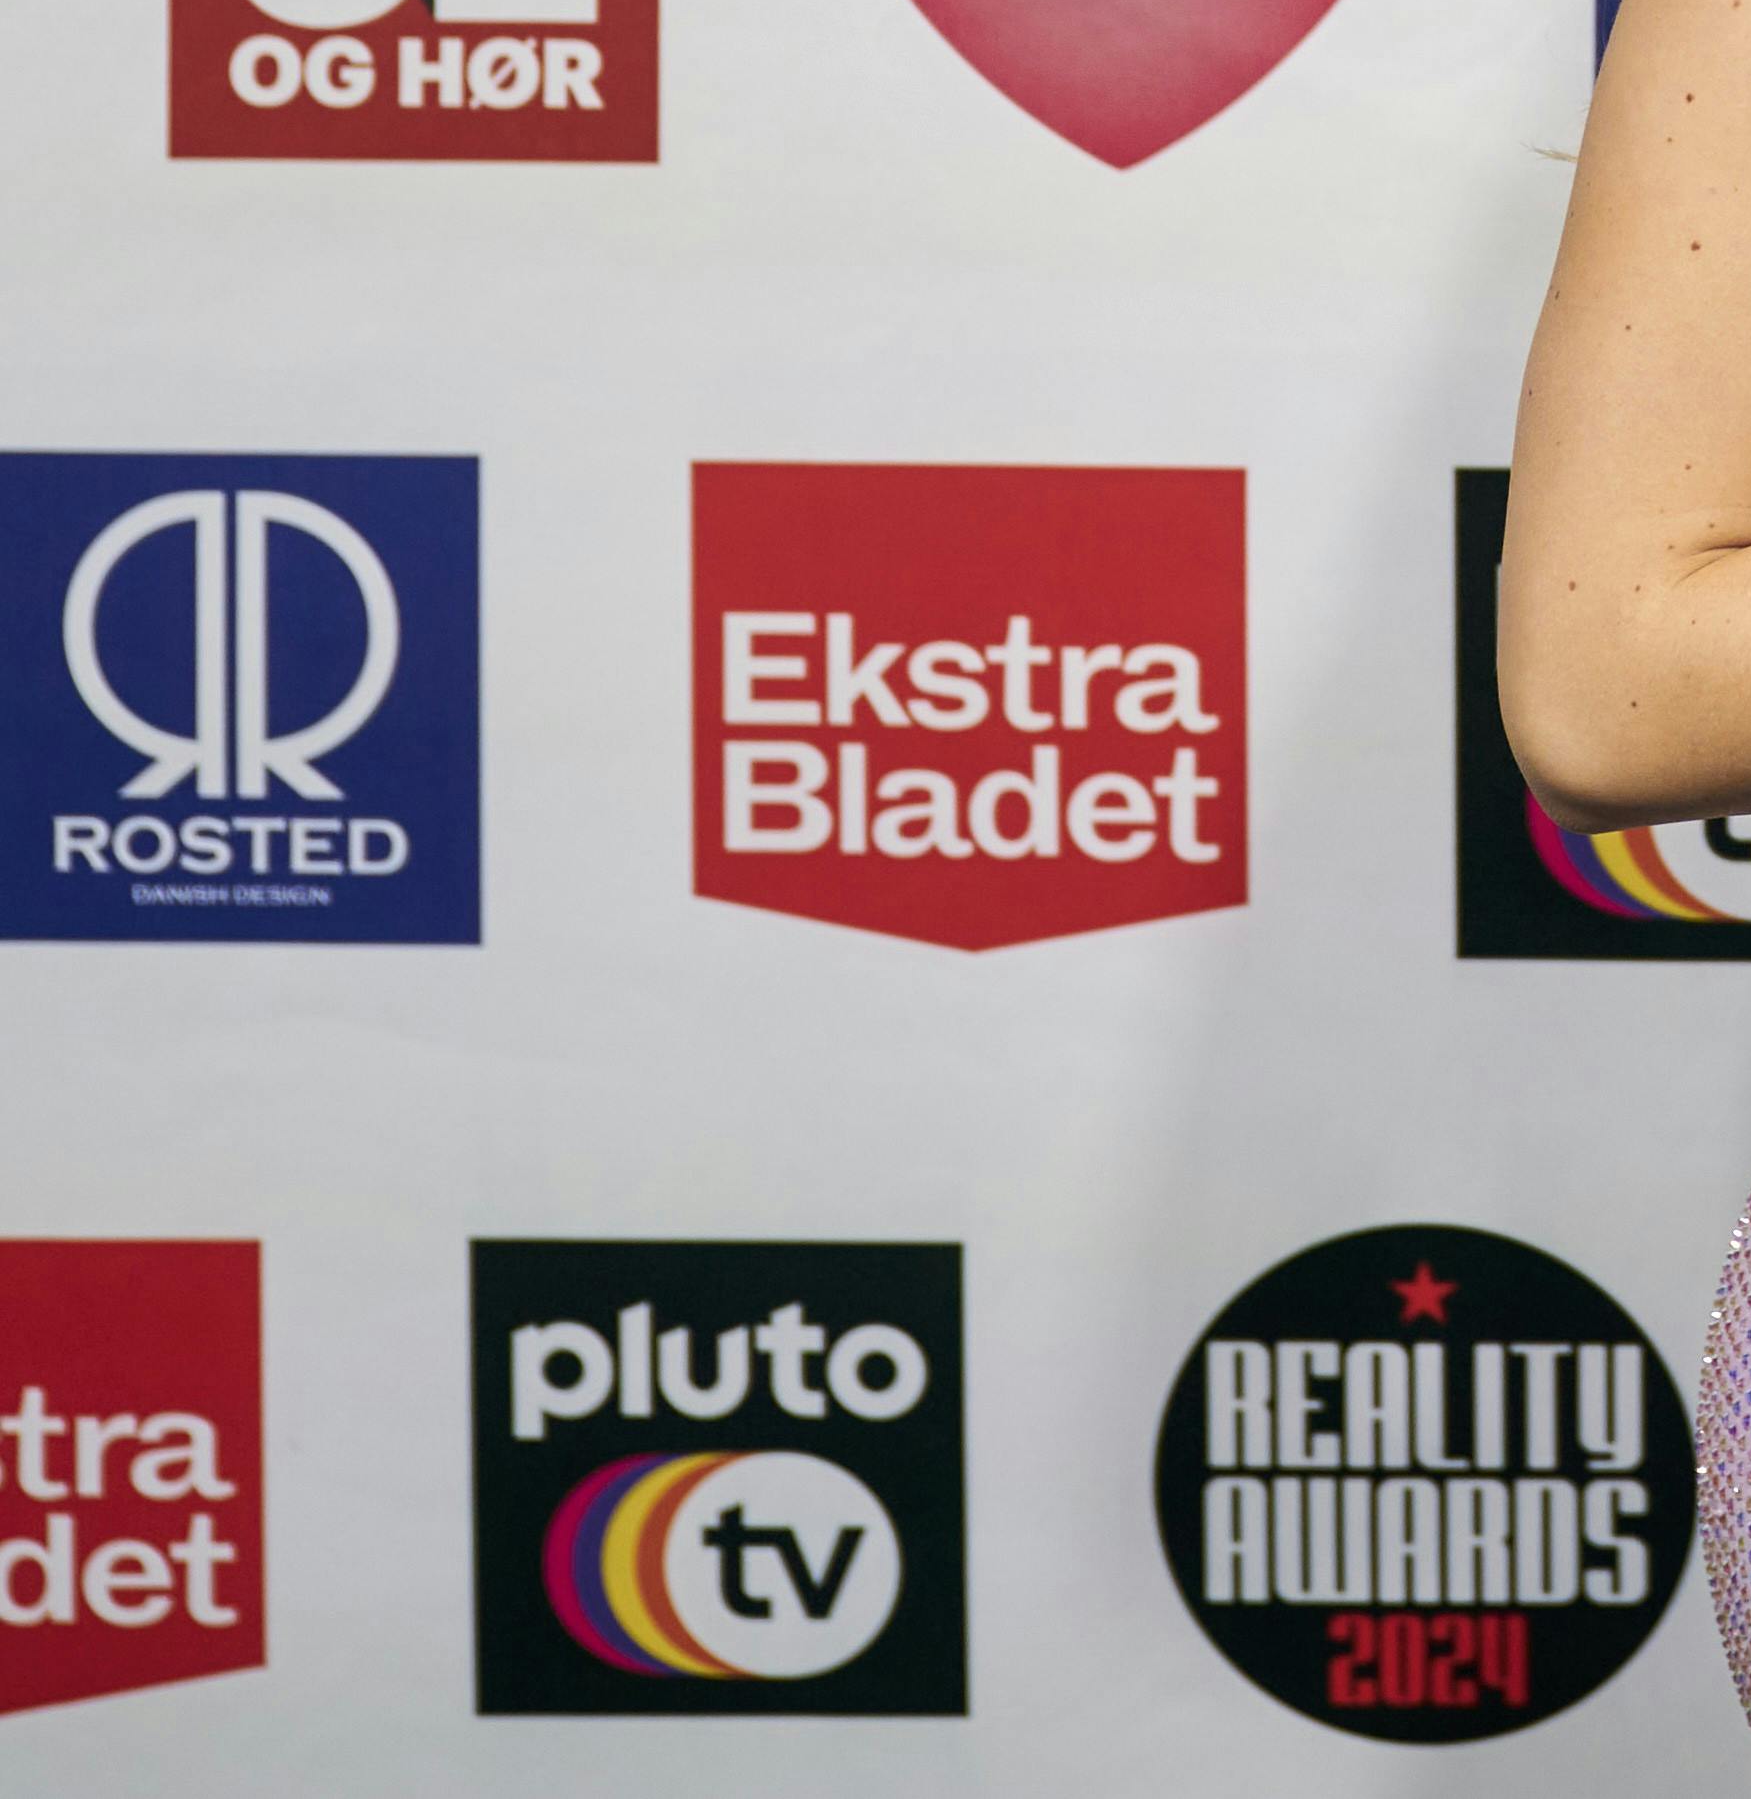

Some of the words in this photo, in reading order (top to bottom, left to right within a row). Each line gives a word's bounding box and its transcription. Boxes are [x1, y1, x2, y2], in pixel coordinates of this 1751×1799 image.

[227, 34, 377, 109] OG
[399, 36, 604, 111] HØR
[722, 611, 1219, 732] Ekstra
[52, 815, 410, 875] ROSTED
[722, 742, 1219, 862] Bladet
[510, 1302, 929, 1440] pluto
[1206, 1341, 1643, 1470] REALITY
[702, 1503, 866, 1620] tv
[1203, 1477, 1649, 1604] AWARDS
[1326, 1612, 1530, 1708] 2024
